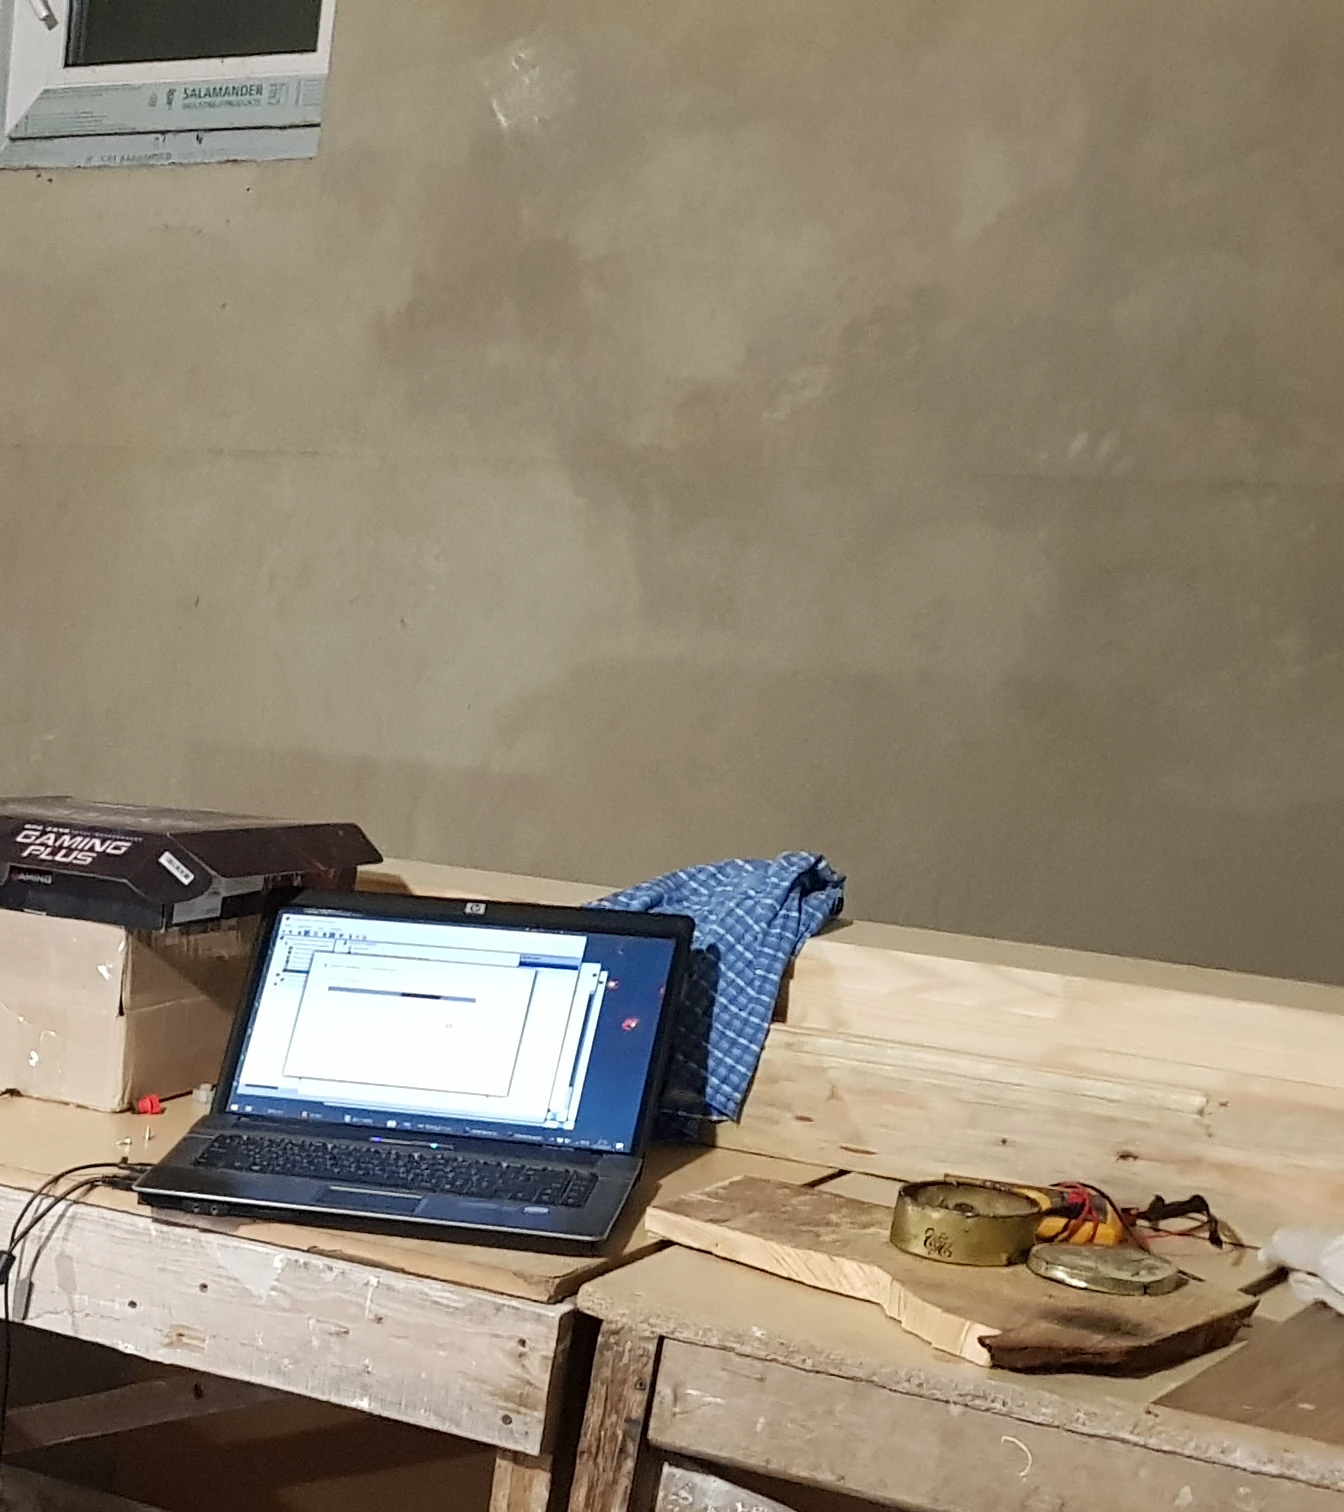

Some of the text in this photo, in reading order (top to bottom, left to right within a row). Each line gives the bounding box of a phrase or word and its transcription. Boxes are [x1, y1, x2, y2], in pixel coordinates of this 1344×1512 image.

[183, 84, 263, 100] SALAMANDER
[15, 830, 132, 855] GAMING
[21, 846, 98, 866] PLUS
